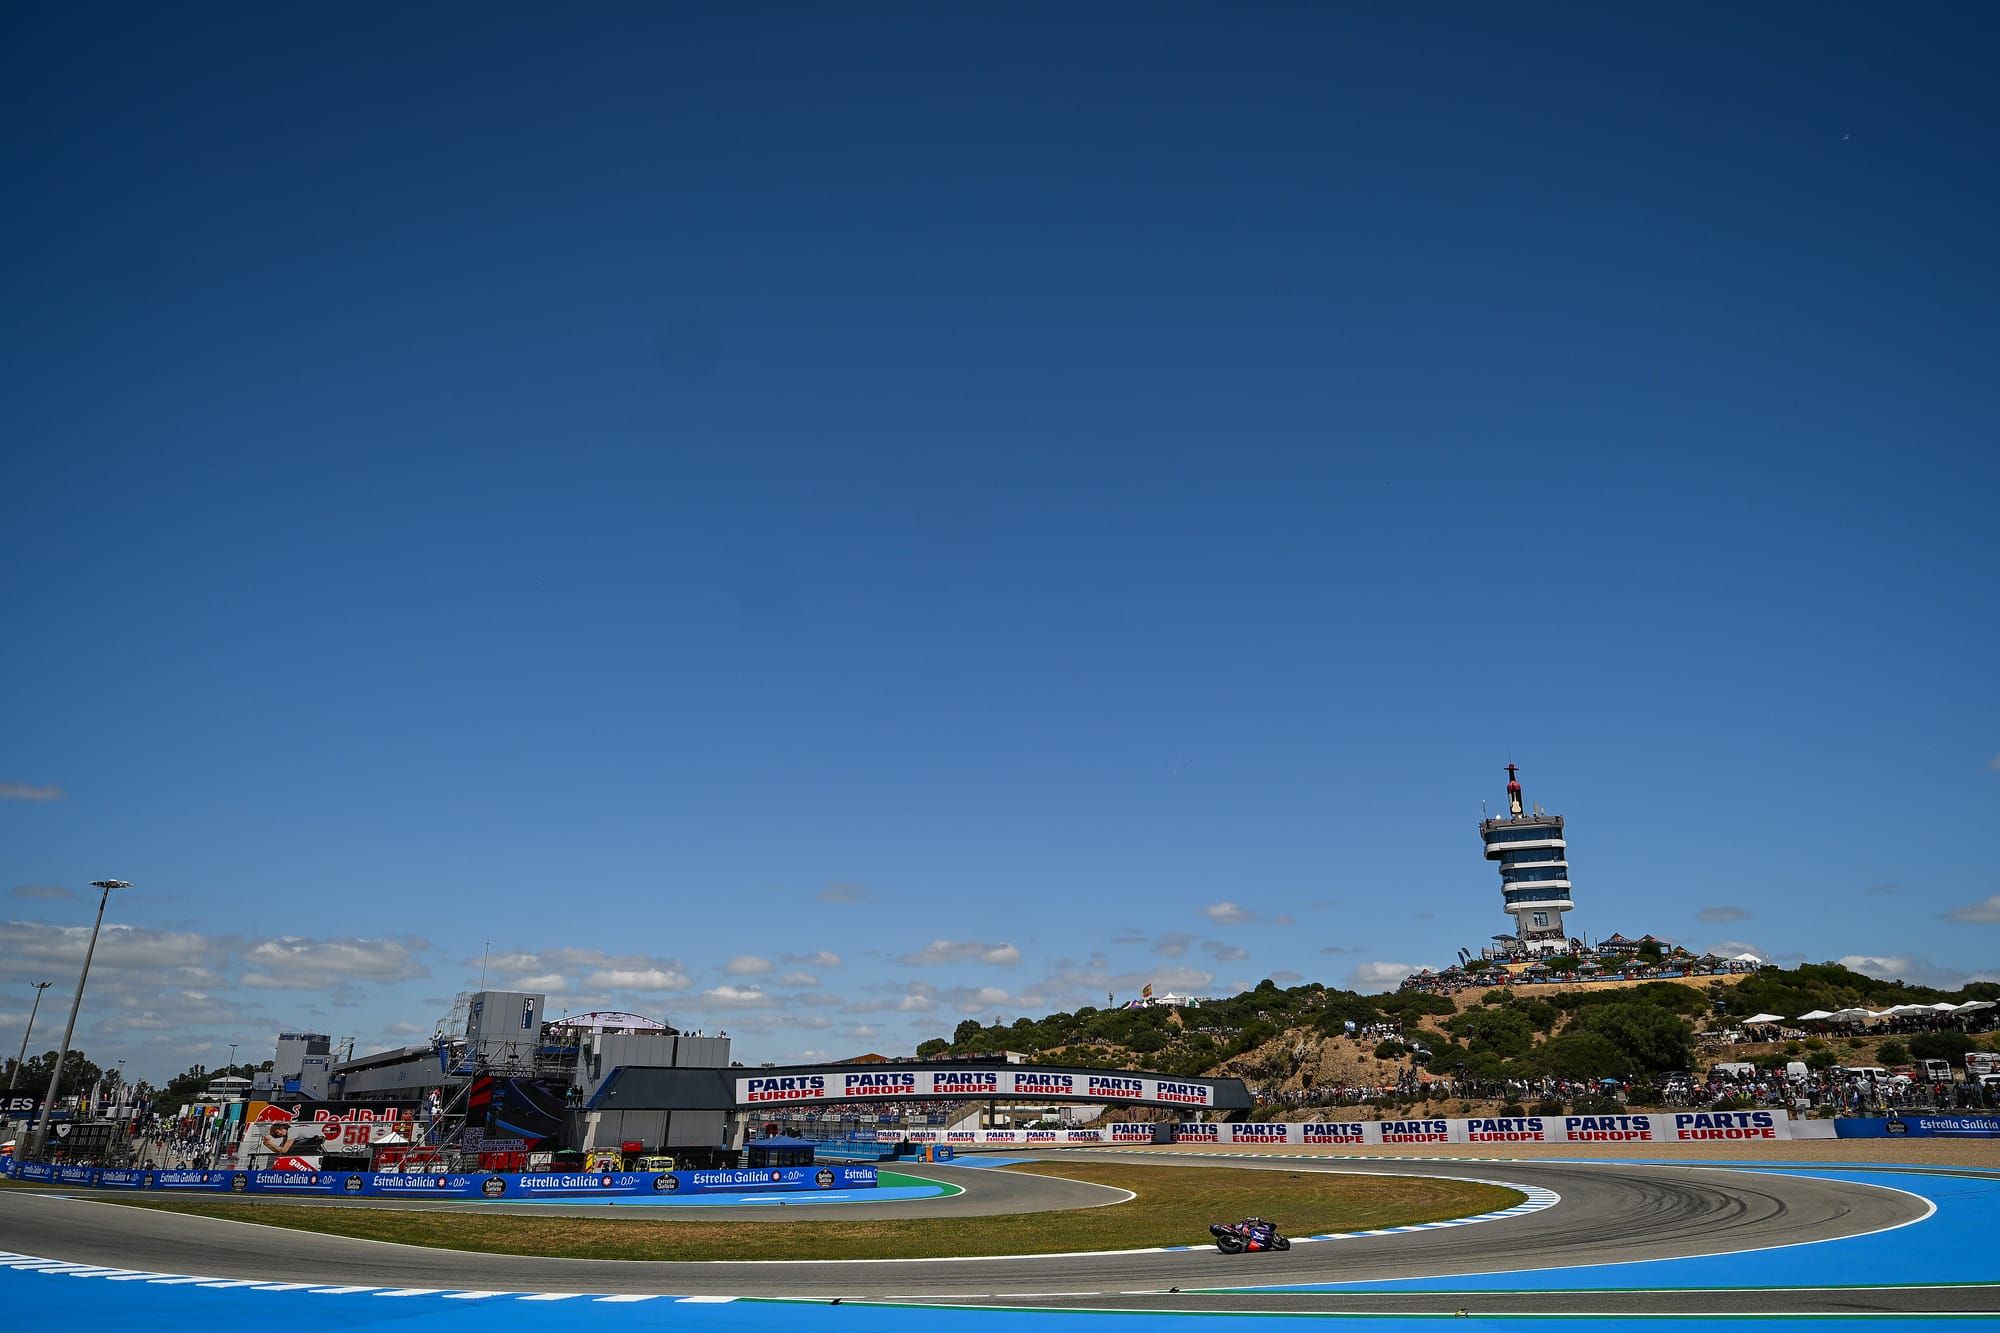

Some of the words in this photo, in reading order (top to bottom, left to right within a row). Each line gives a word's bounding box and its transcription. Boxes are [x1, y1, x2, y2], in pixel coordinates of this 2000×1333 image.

[748, 1076, 824, 1092] PARTS
[845, 1073, 914, 1086] PARTS
[933, 1073, 997, 1085] PARTS
[1015, 1073, 1073, 1086] PARTS
[1089, 1077, 1142, 1090] PARTS
[845, 1086, 914, 1096] EUROPE
[933, 1084, 997, 1093] EUROPE
[1014, 1085, 1073, 1094] EUROPE
[1089, 1089, 1142, 1098] EUROPE
[1157, 1082, 1207, 1096] PARTS
[748, 1089, 824, 1101] EUROPE
[1157, 1093, 1207, 1104] EUROPE
[1468, 1118, 1543, 1132] PARTS
[1565, 1116, 1650, 1131] PARTS
[1675, 1112, 1773, 1129] PARTS
[1920, 1119, 1960, 1129] Estrella
[1961, 1119, 1999, 1129] Galicia
[1112, 1124, 1156, 1134] PARTS
[1170, 1124, 1218, 1135] PARTS
[1232, 1124, 1286, 1135] PARTS
[1303, 1123, 1362, 1136] PARTS
[1381, 1120, 1447, 1134] PARTS
[343, 1125, 371, 1145] 58
[1112, 1134, 1157, 1142] EUROPE
[1232, 1135, 1287, 1143] EUROPE
[1382, 1134, 1448, 1142] EUROPE
[1469, 1132, 1545, 1141] EUROPE
[1567, 1130, 1652, 1141] EUROPE
[1678, 1128, 1776, 1139] EUROPE
[256, 1173, 282, 1184] Estrella
[284, 1173, 308, 1184] Galicia
[693, 1173, 732, 1184] Estrella
[735, 1171, 768, 1182] Galicia
[845, 1168, 872, 1179] Estrella
[373, 1176, 403, 1187] Estrella
[405, 1176, 434, 1187] Galicia
[520, 1176, 558, 1188] Estrella
[562, 1176, 598, 1188] Galicia
